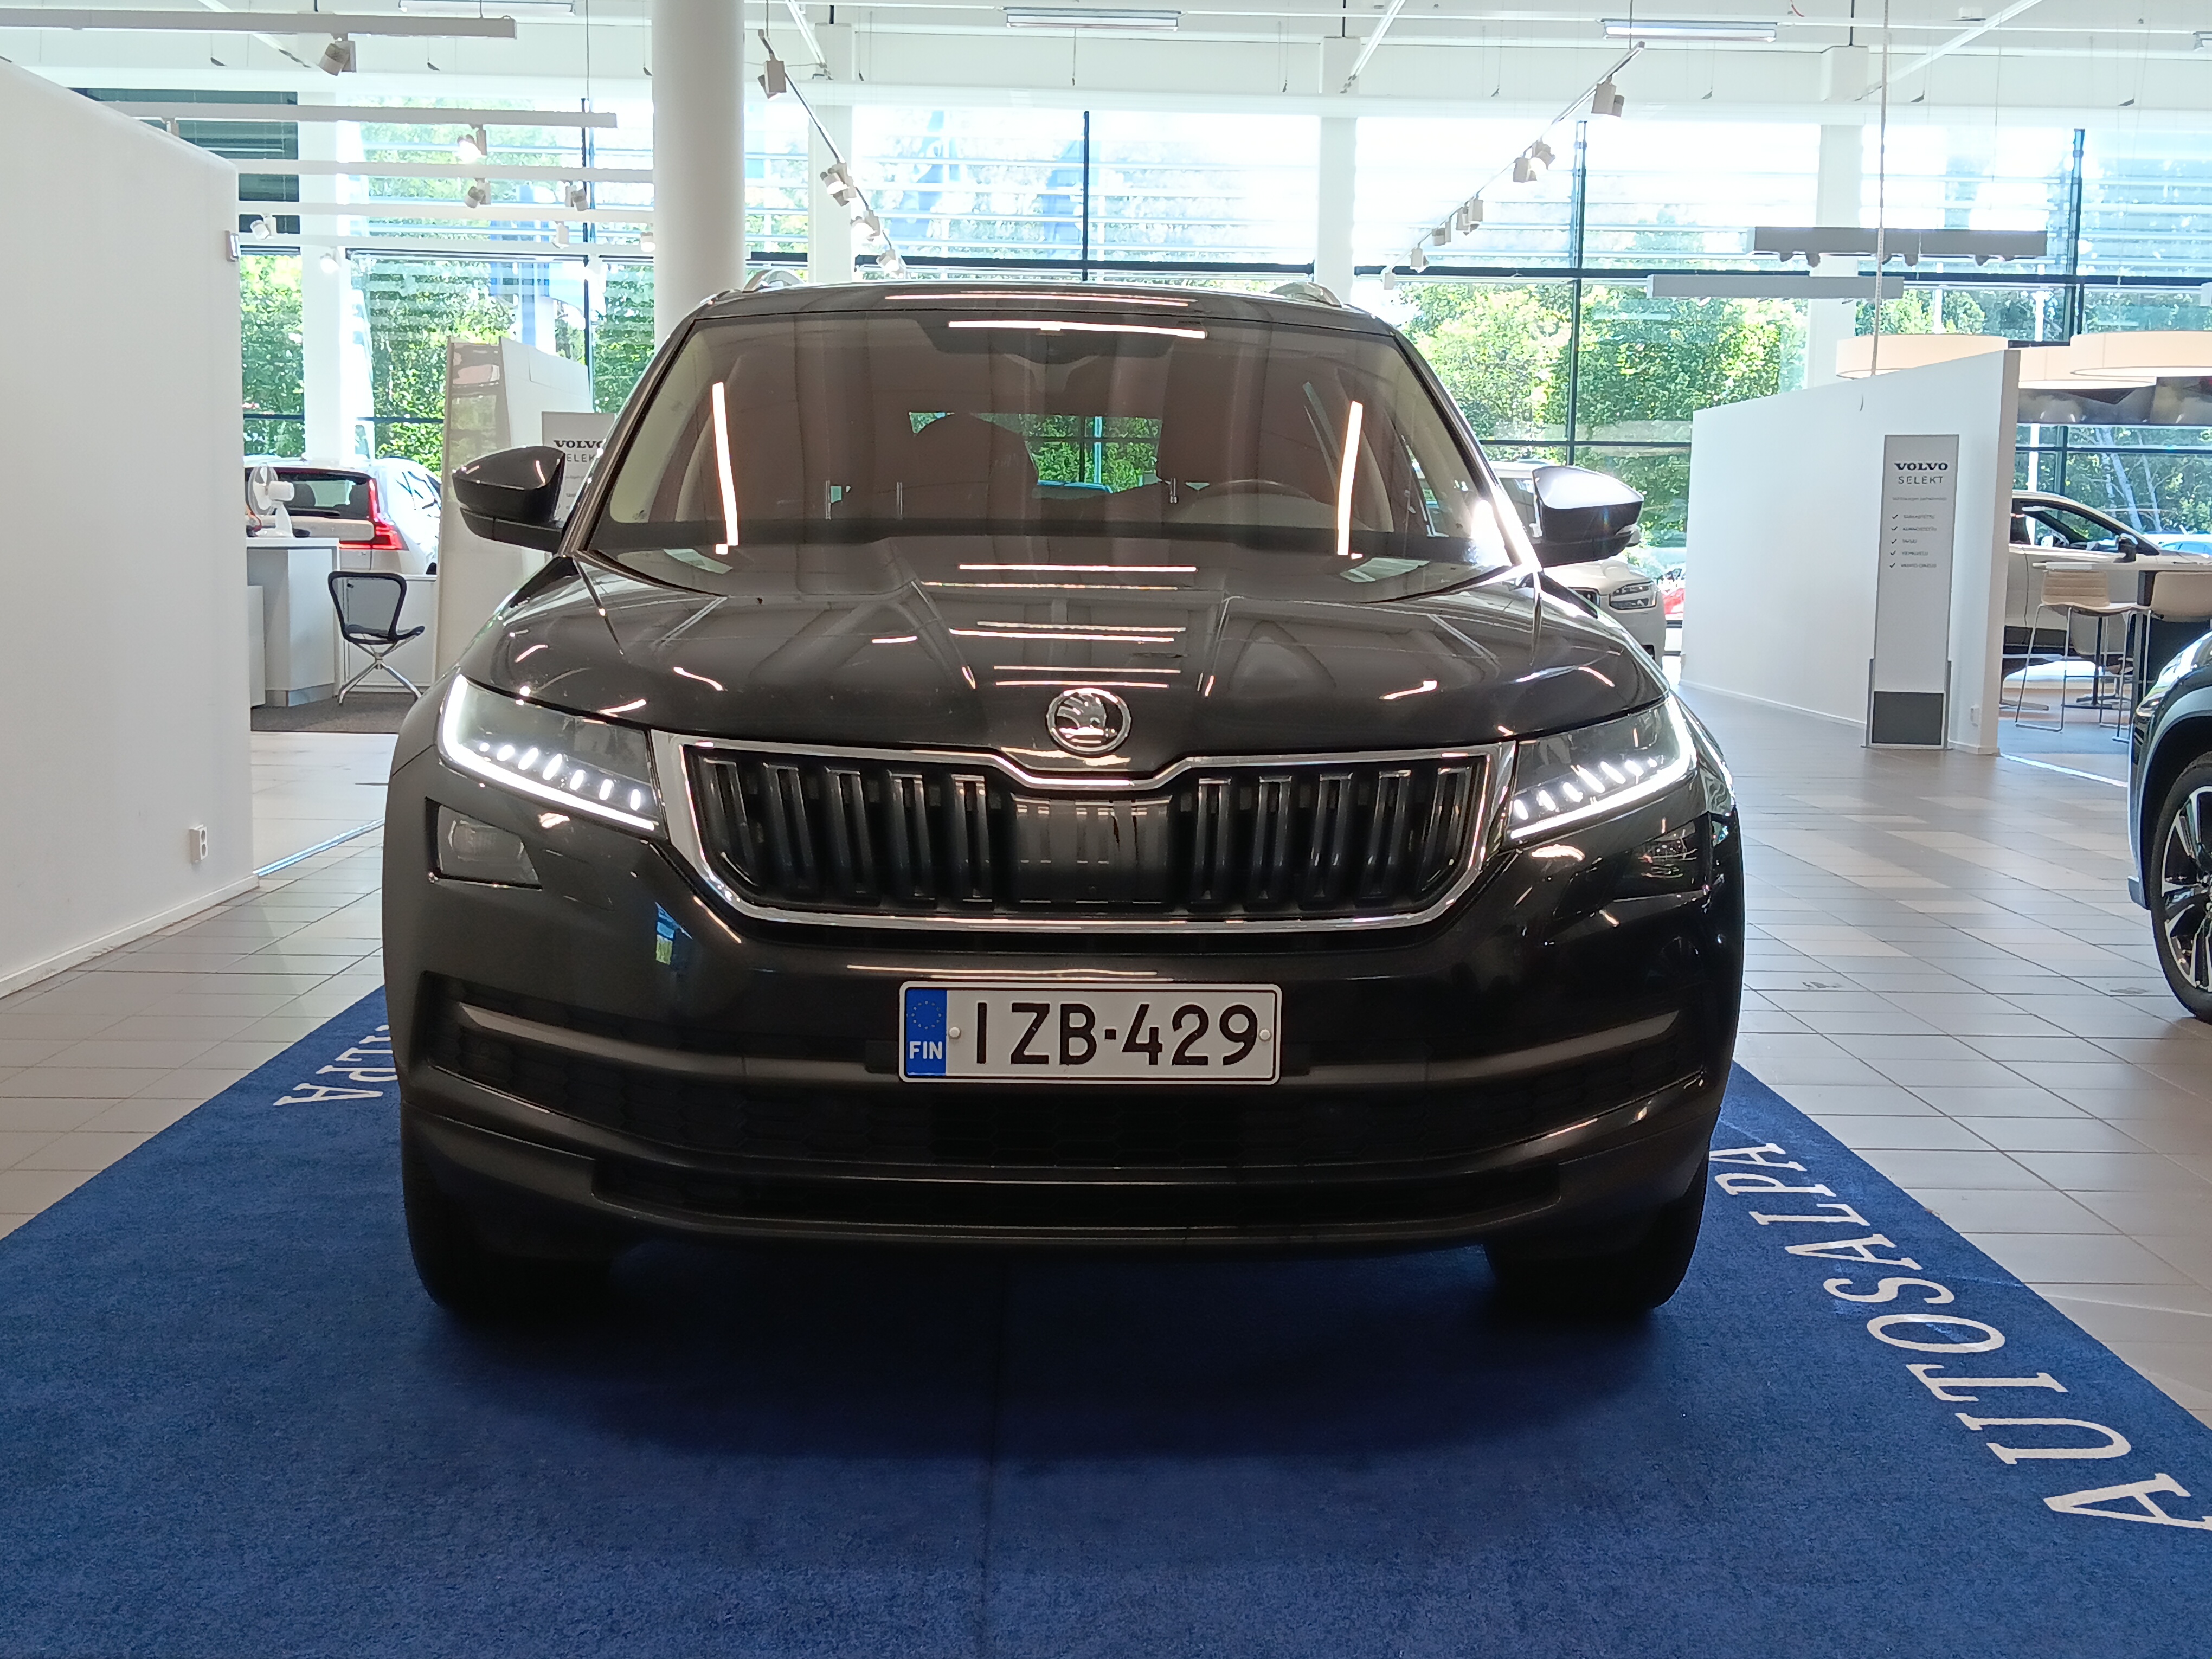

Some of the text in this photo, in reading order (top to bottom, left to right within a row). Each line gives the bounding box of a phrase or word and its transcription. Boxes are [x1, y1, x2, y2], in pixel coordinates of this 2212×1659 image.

[566, 453, 595, 462] ELEK
[1894, 462, 1949, 471] VOLVO
[1898, 475, 1943, 484] SELEKT
[976, 1001, 1258, 1066] IZB-429
[909, 1041, 943, 1059] FIN
[1709, 1143, 2212, 1531] AUTOSALPA
